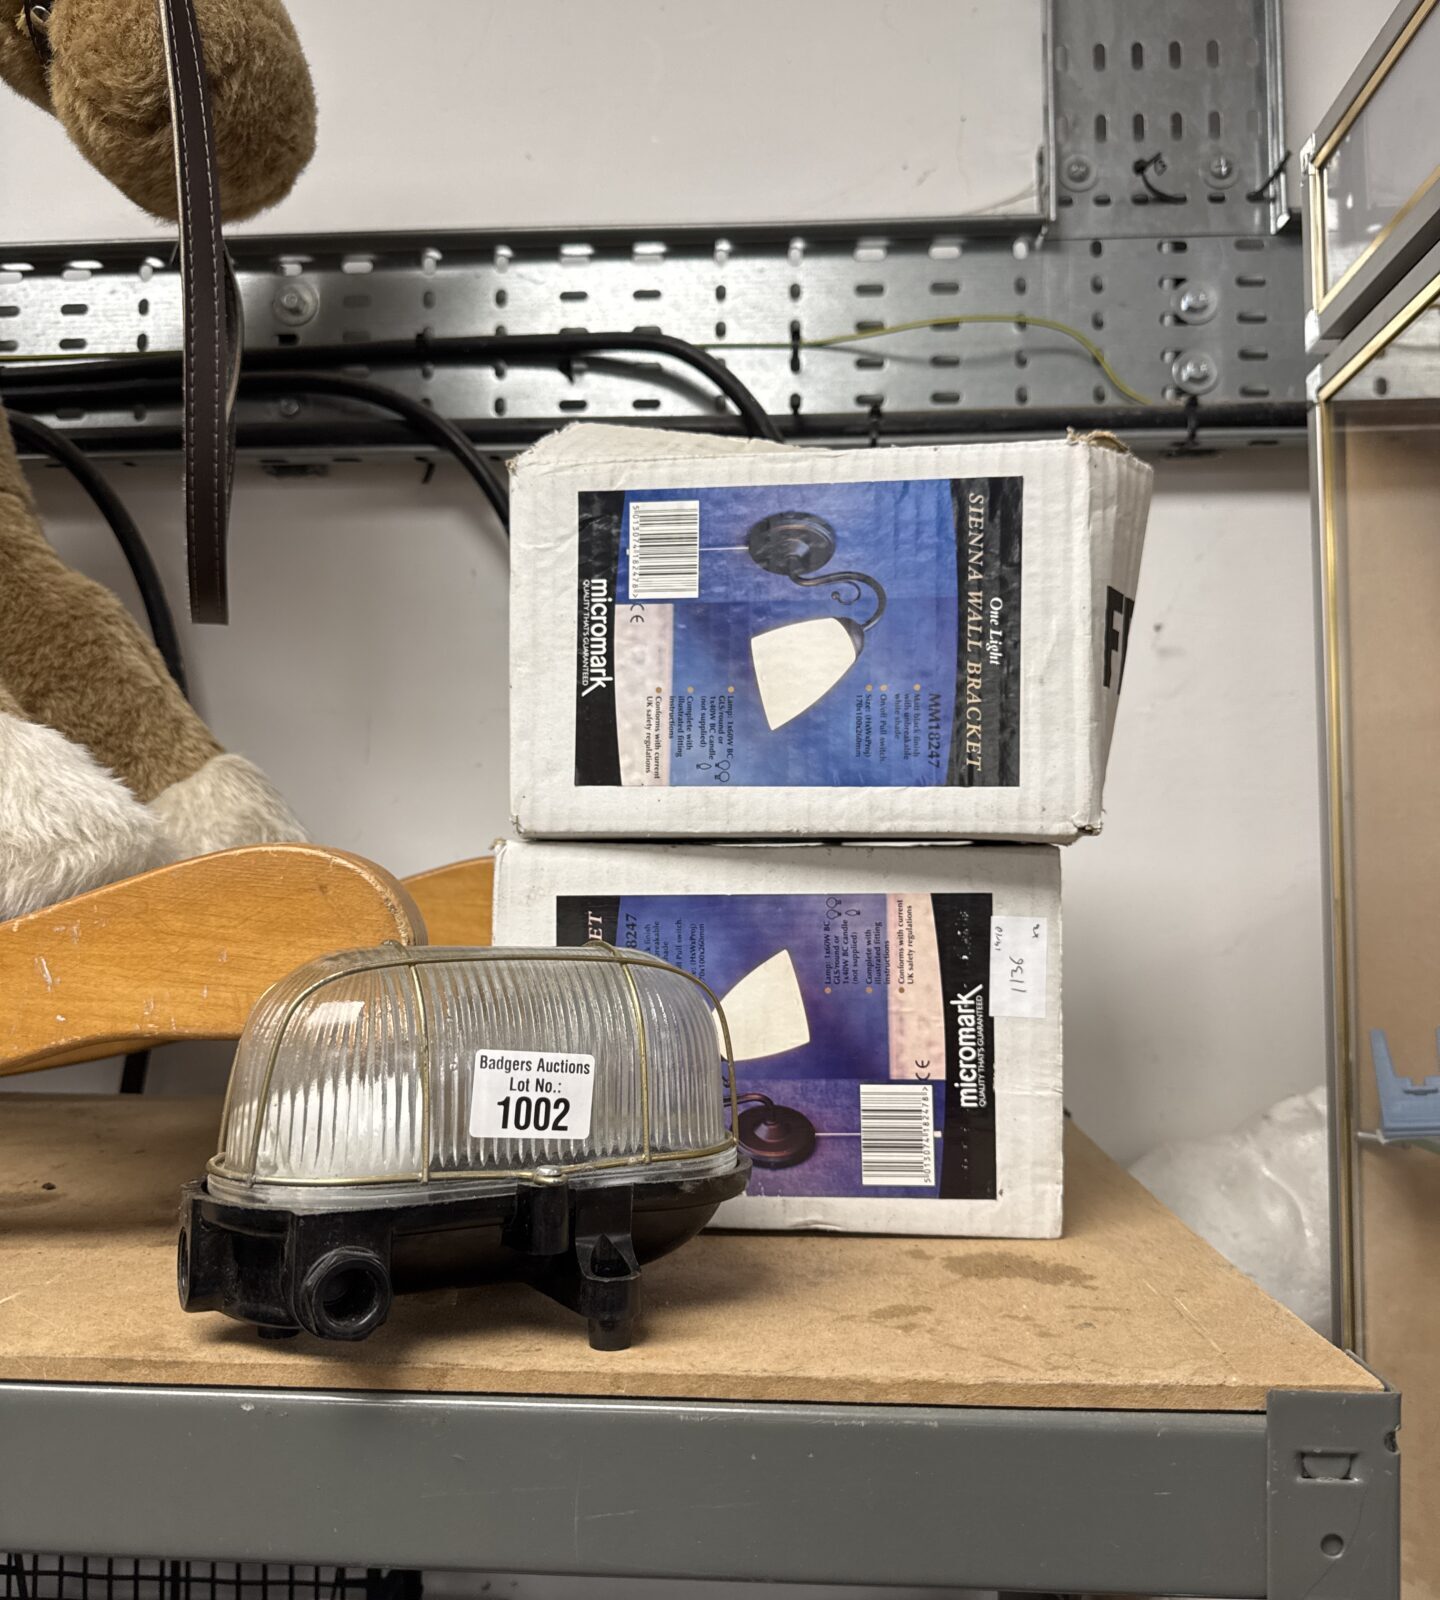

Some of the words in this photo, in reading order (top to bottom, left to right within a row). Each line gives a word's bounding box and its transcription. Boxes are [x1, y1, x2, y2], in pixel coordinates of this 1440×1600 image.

[967, 492, 985, 581] SIENNA
[582, 580, 590, 610] QUALITY
[990, 597, 1003, 625] One
[582, 612, 590, 636] THAT'S
[582, 579, 614, 697] micromark
[966, 591, 983, 652] WALL
[582, 637, 590, 687] GUARANTEED
[986, 630, 1003, 665] Light
[646, 696, 652, 707] UK
[726, 696, 734, 718] Lamp:
[965, 660, 983, 772] BRACKET
[709, 723, 715, 733] BC
[928, 693, 941, 768] MM18247
[644, 733, 652, 773] regulations
[675, 736, 684, 757] fitting
[727, 748, 733, 759] BC
[626, 913, 637, 947] 8247
[824, 921, 830, 931] BC
[874, 922, 882, 944] fitting
[905, 906, 914, 947] regulations
[689, 923, 697, 965] (HxWxProj)
[842, 946, 848, 956] BC
[851, 932, 859, 967] supplied)
[906, 949, 914, 970] safety
[866, 948, 874, 984] Complete
[907, 973, 914, 984] UK
[1009, 956, 1027, 993] 1136
[975, 995, 984, 1046] GUARANTEED
[950, 984, 983, 1107] micromark
[977, 1047, 985, 1073] THAT'S
[480, 1055, 532, 1073] Badgers
[537, 1058, 590, 1074] Auctions
[510, 1077, 530, 1092] Lot
[536, 1079, 562, 1093] No.:
[977, 1074, 987, 1107] QUALITY
[497, 1096, 570, 1131] 1002
